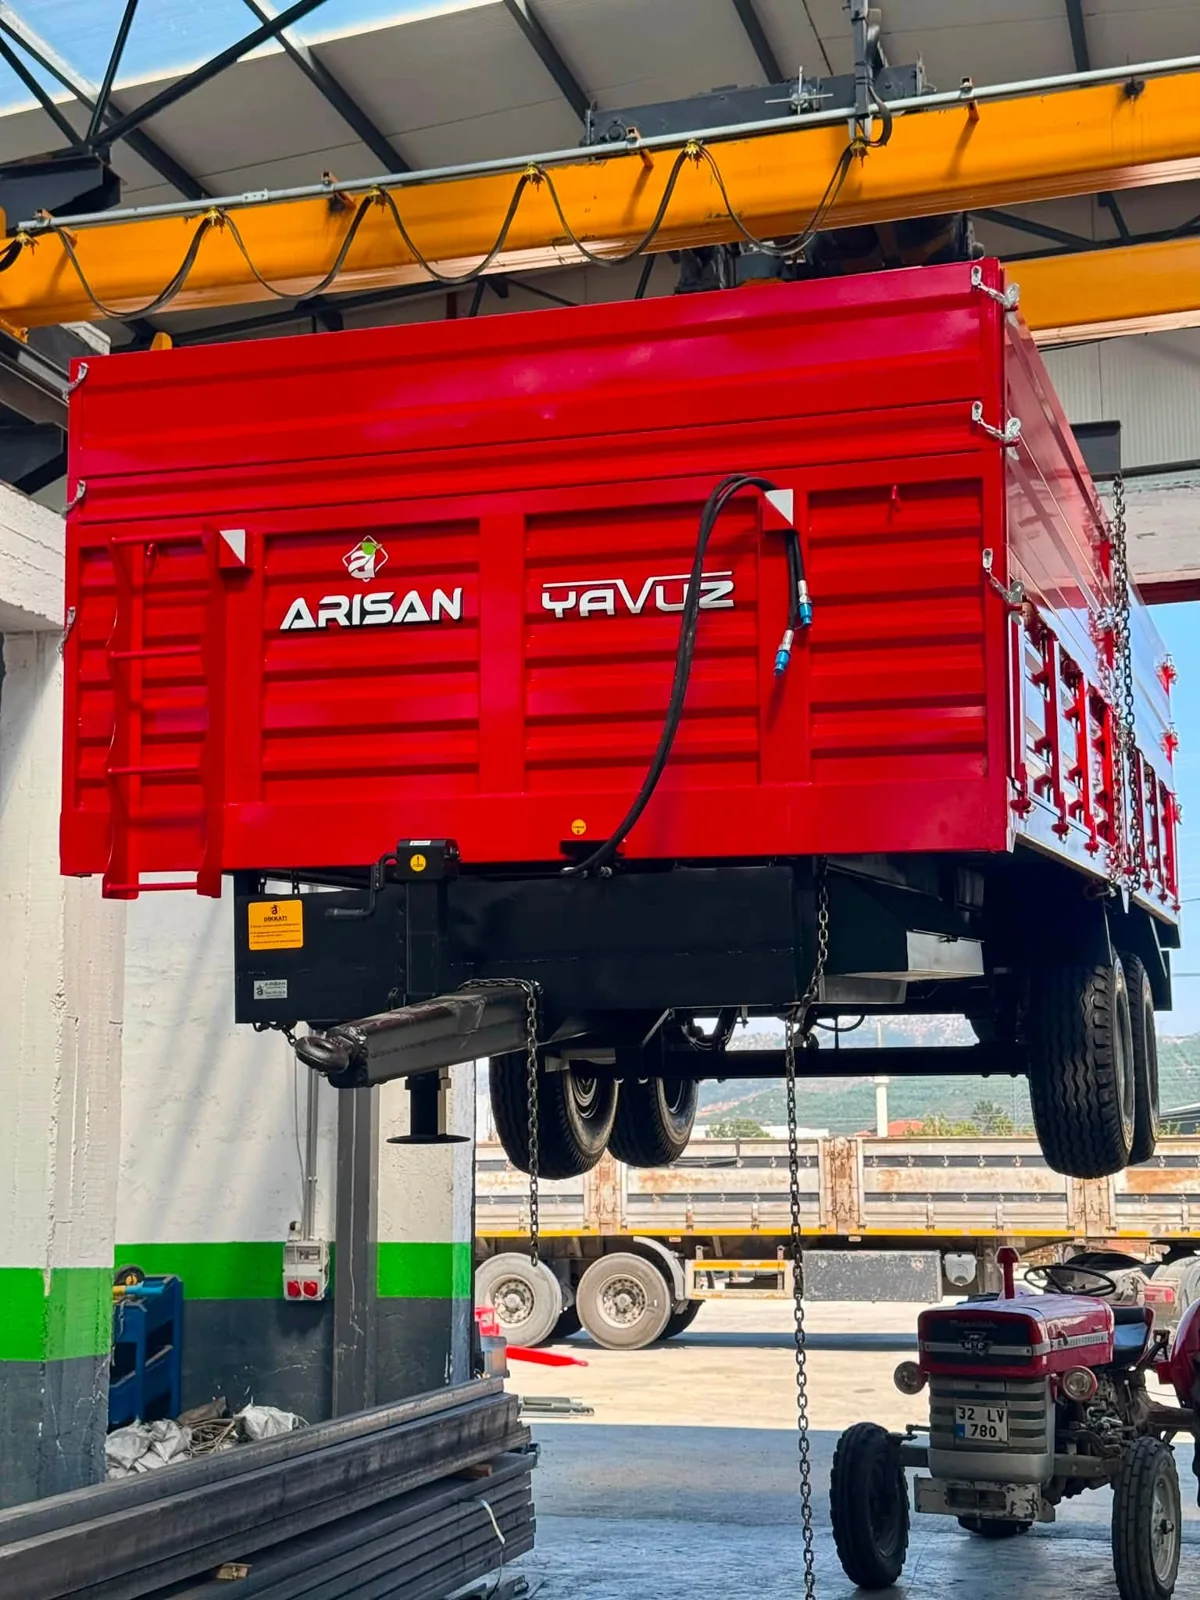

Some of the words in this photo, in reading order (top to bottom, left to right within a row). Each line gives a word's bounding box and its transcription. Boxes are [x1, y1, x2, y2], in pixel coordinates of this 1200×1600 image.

[279, 587, 463, 631] ARISAN
[541, 570, 735, 618] YAVUZ
[957, 1406, 975, 1420] 32
[987, 1409, 1004, 1422] LV
[970, 1423, 997, 1438] 780
